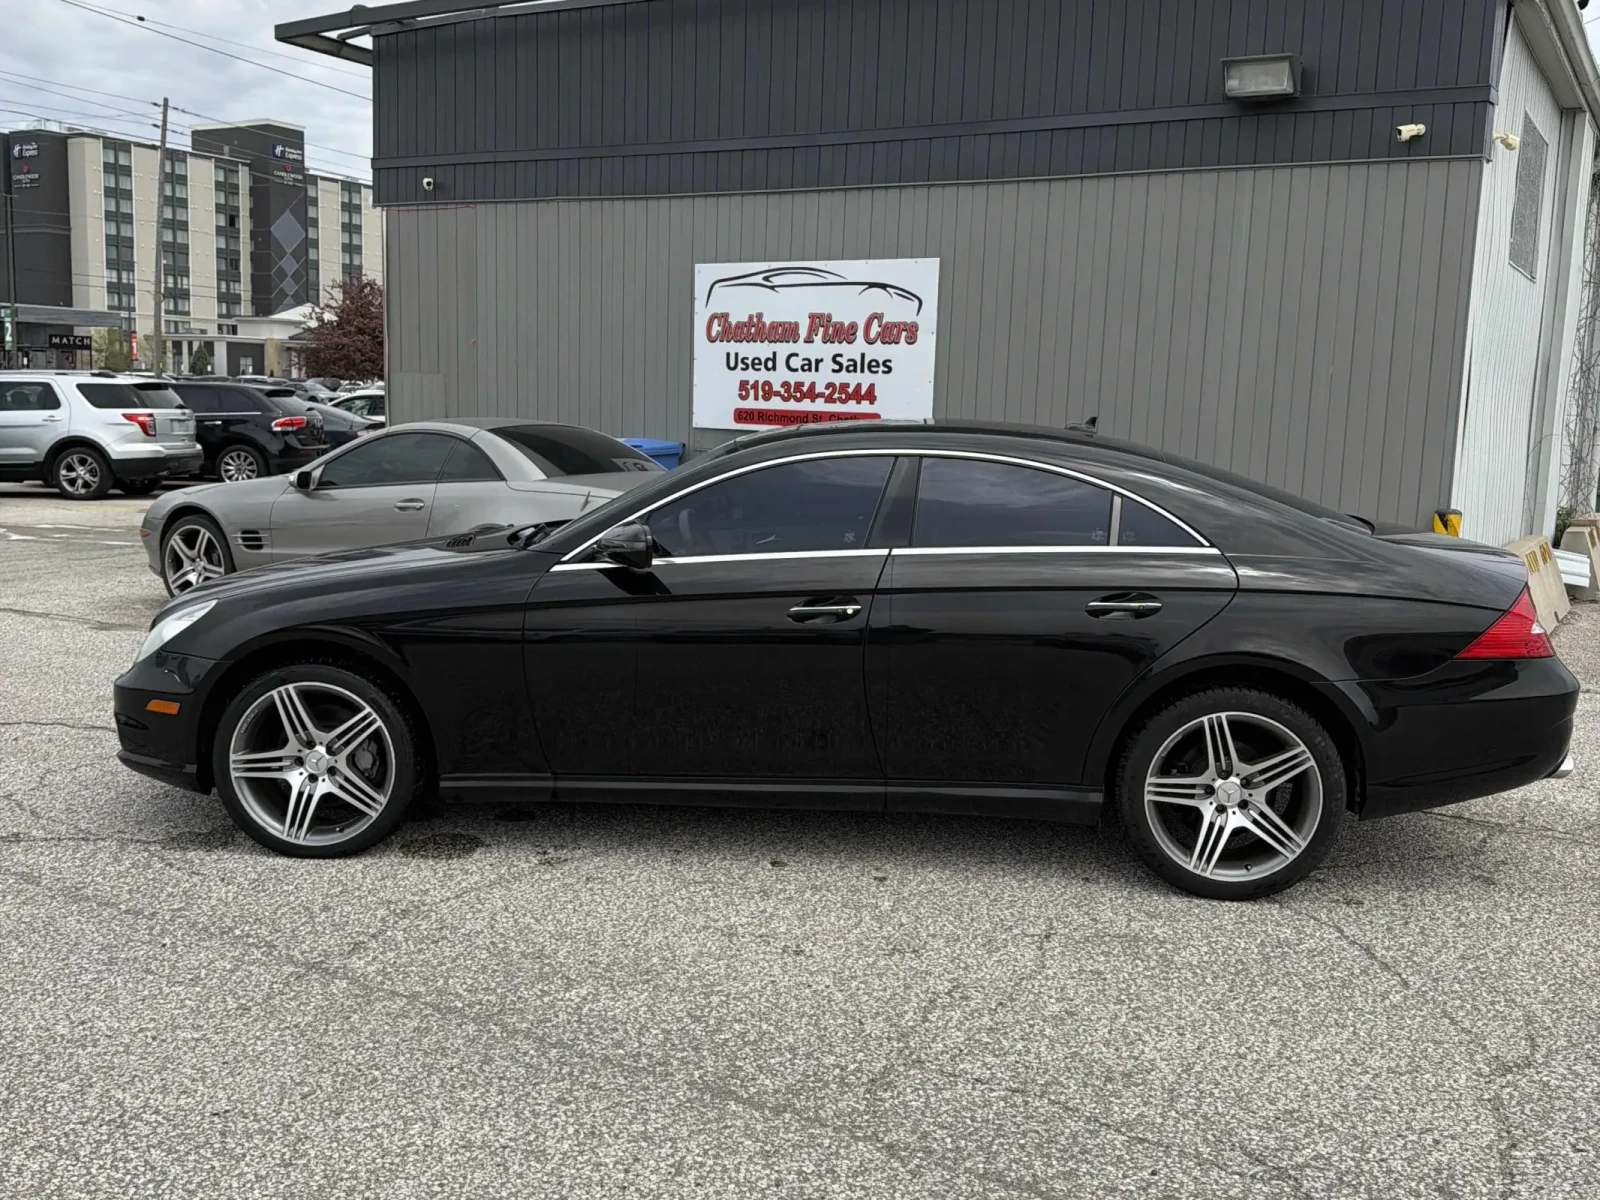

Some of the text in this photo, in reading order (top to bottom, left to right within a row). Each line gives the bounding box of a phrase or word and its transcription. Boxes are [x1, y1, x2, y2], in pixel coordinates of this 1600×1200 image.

[5, 322, 12, 341] 2
[706, 312, 919, 345] Chatham Fine Cars
[51, 336, 90, 345] MATCH
[726, 351, 893, 374] Used Car Sales
[738, 380, 877, 405] 519-354-2544
[737, 411, 754, 421] 620
[757, 411, 808, 424] Richmond
